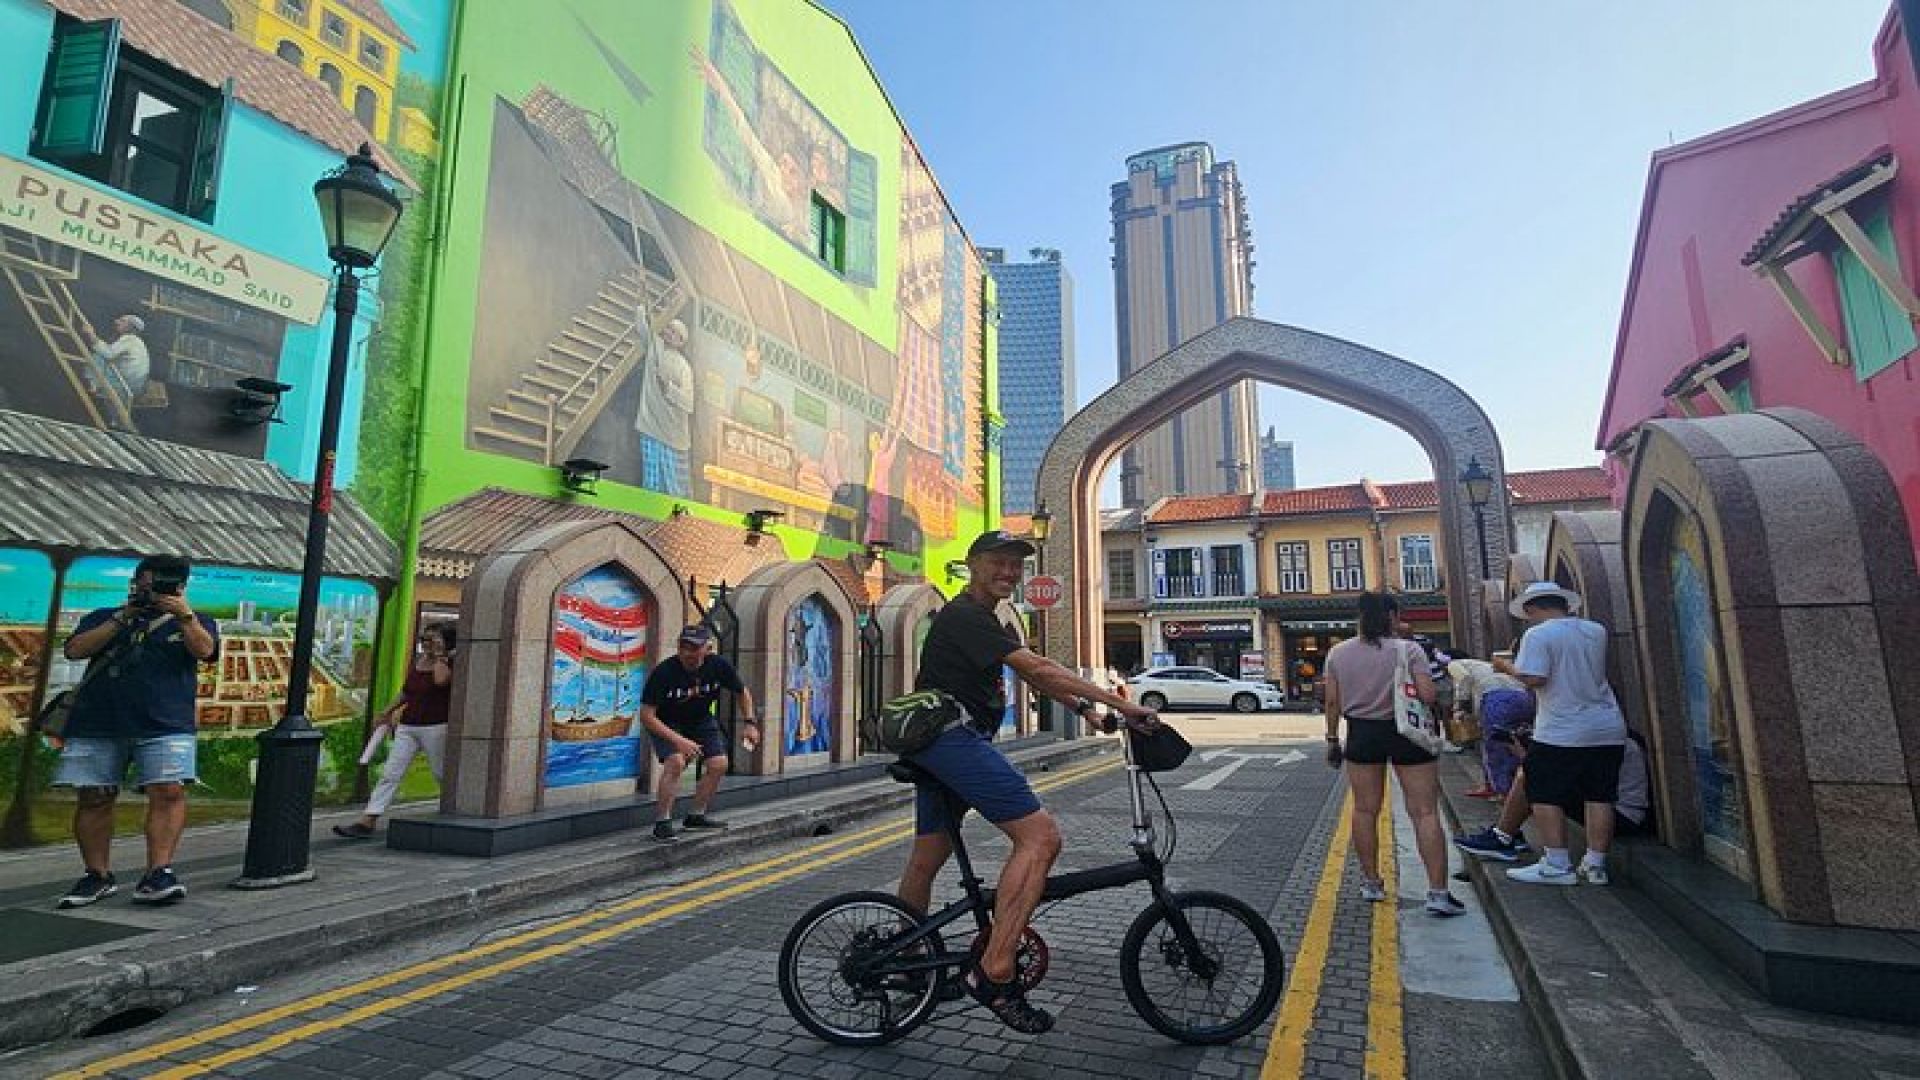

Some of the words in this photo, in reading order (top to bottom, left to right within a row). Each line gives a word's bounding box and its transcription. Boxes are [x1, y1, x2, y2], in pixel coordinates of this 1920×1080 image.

[16, 175, 249, 277] PUSTAKA
[60, 219, 225, 286] MUHAMMAD
[242, 282, 293, 309] SAID
[1025, 584, 1061, 600] STOP
